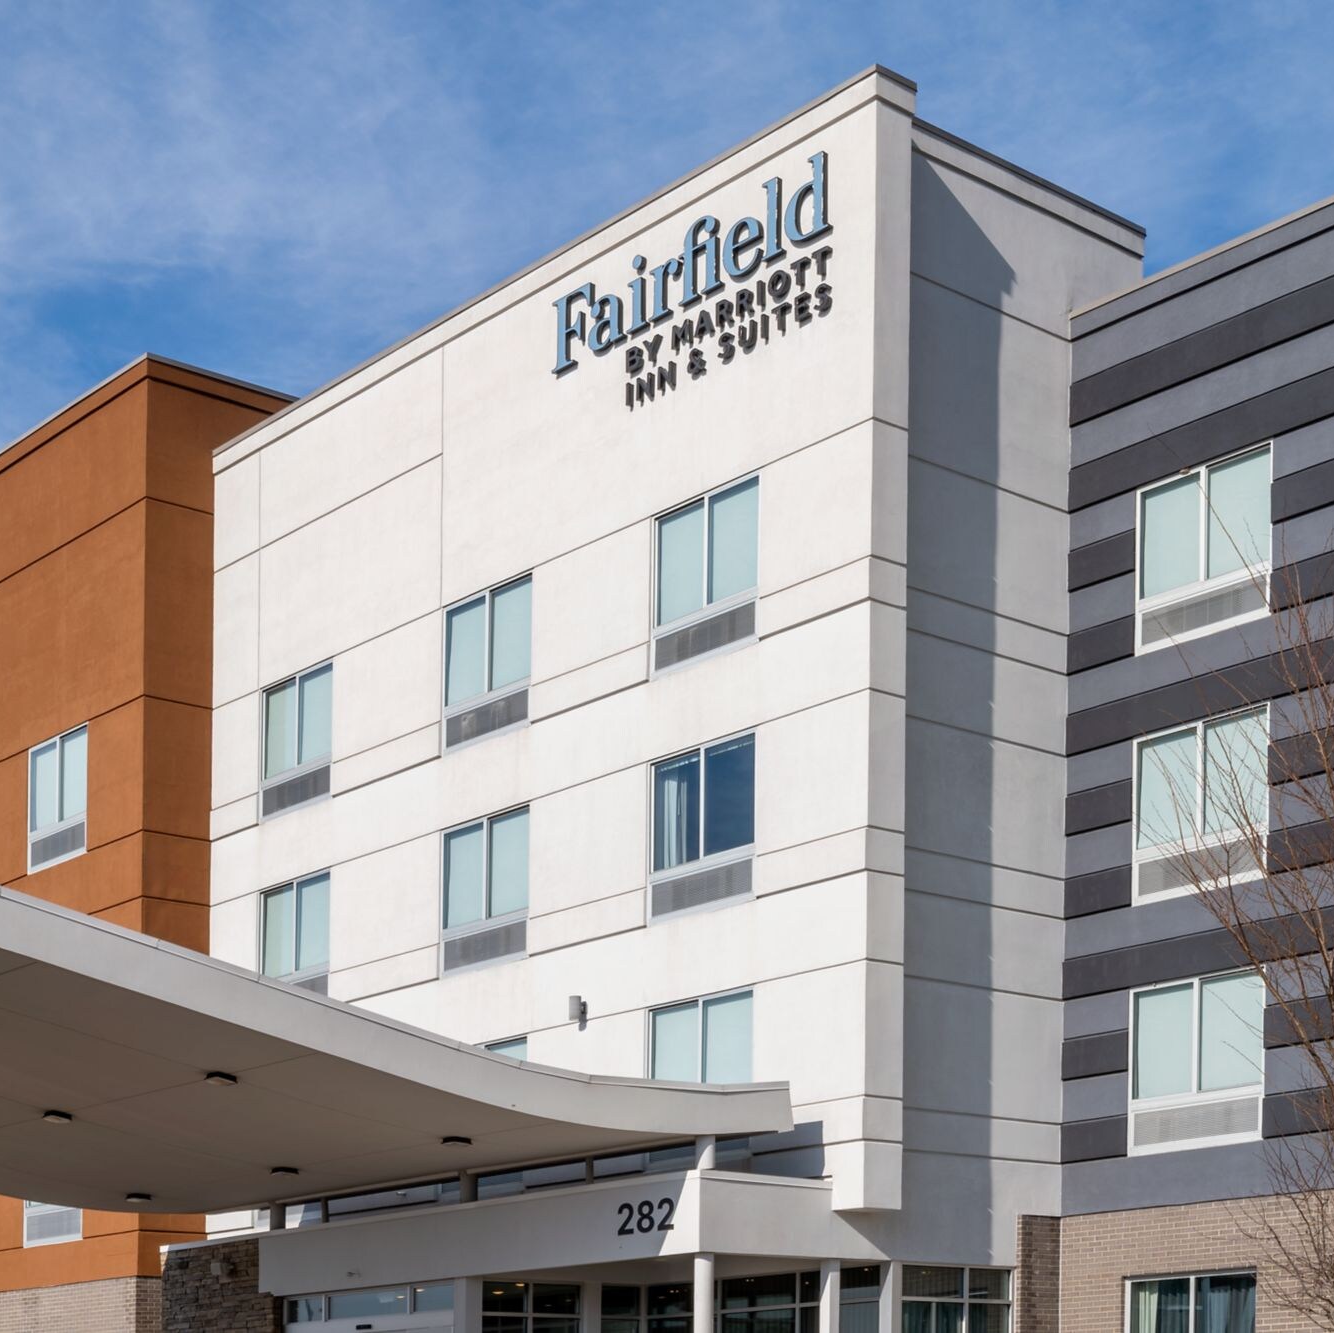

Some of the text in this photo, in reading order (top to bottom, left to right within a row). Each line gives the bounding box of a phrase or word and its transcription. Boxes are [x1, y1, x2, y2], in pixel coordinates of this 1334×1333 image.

[552, 151, 833, 379] Fairfield
[626, 246, 833, 376] BY MARRIOTT
[625, 282, 833, 411] INN & SUITES
[617, 1197, 674, 1236] 282
